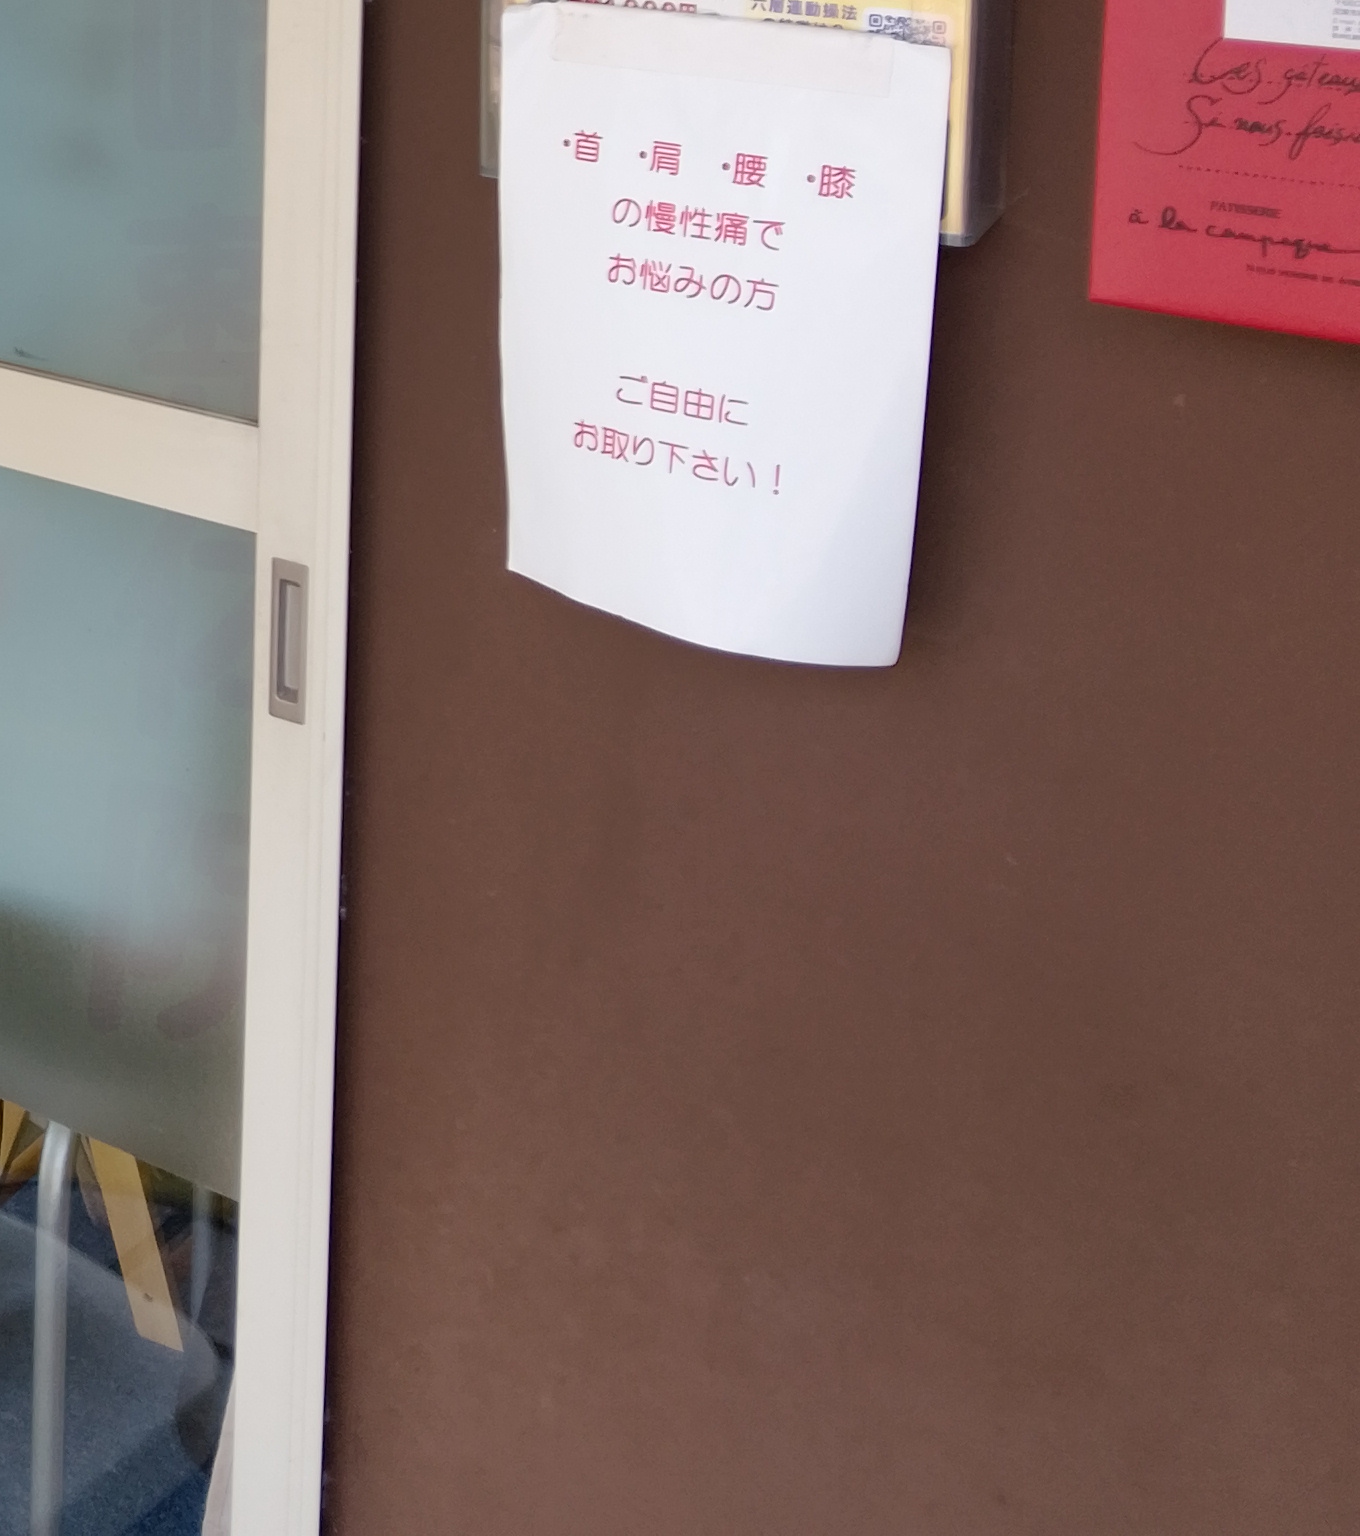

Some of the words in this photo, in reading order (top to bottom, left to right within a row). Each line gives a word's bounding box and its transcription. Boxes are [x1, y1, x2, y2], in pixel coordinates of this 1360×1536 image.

[611, 197, 786, 252] の慢性痛で
[606, 254, 780, 311] お悩みの方
[615, 373, 750, 426] ご自由に
[573, 420, 783, 495] お取り下さい！
